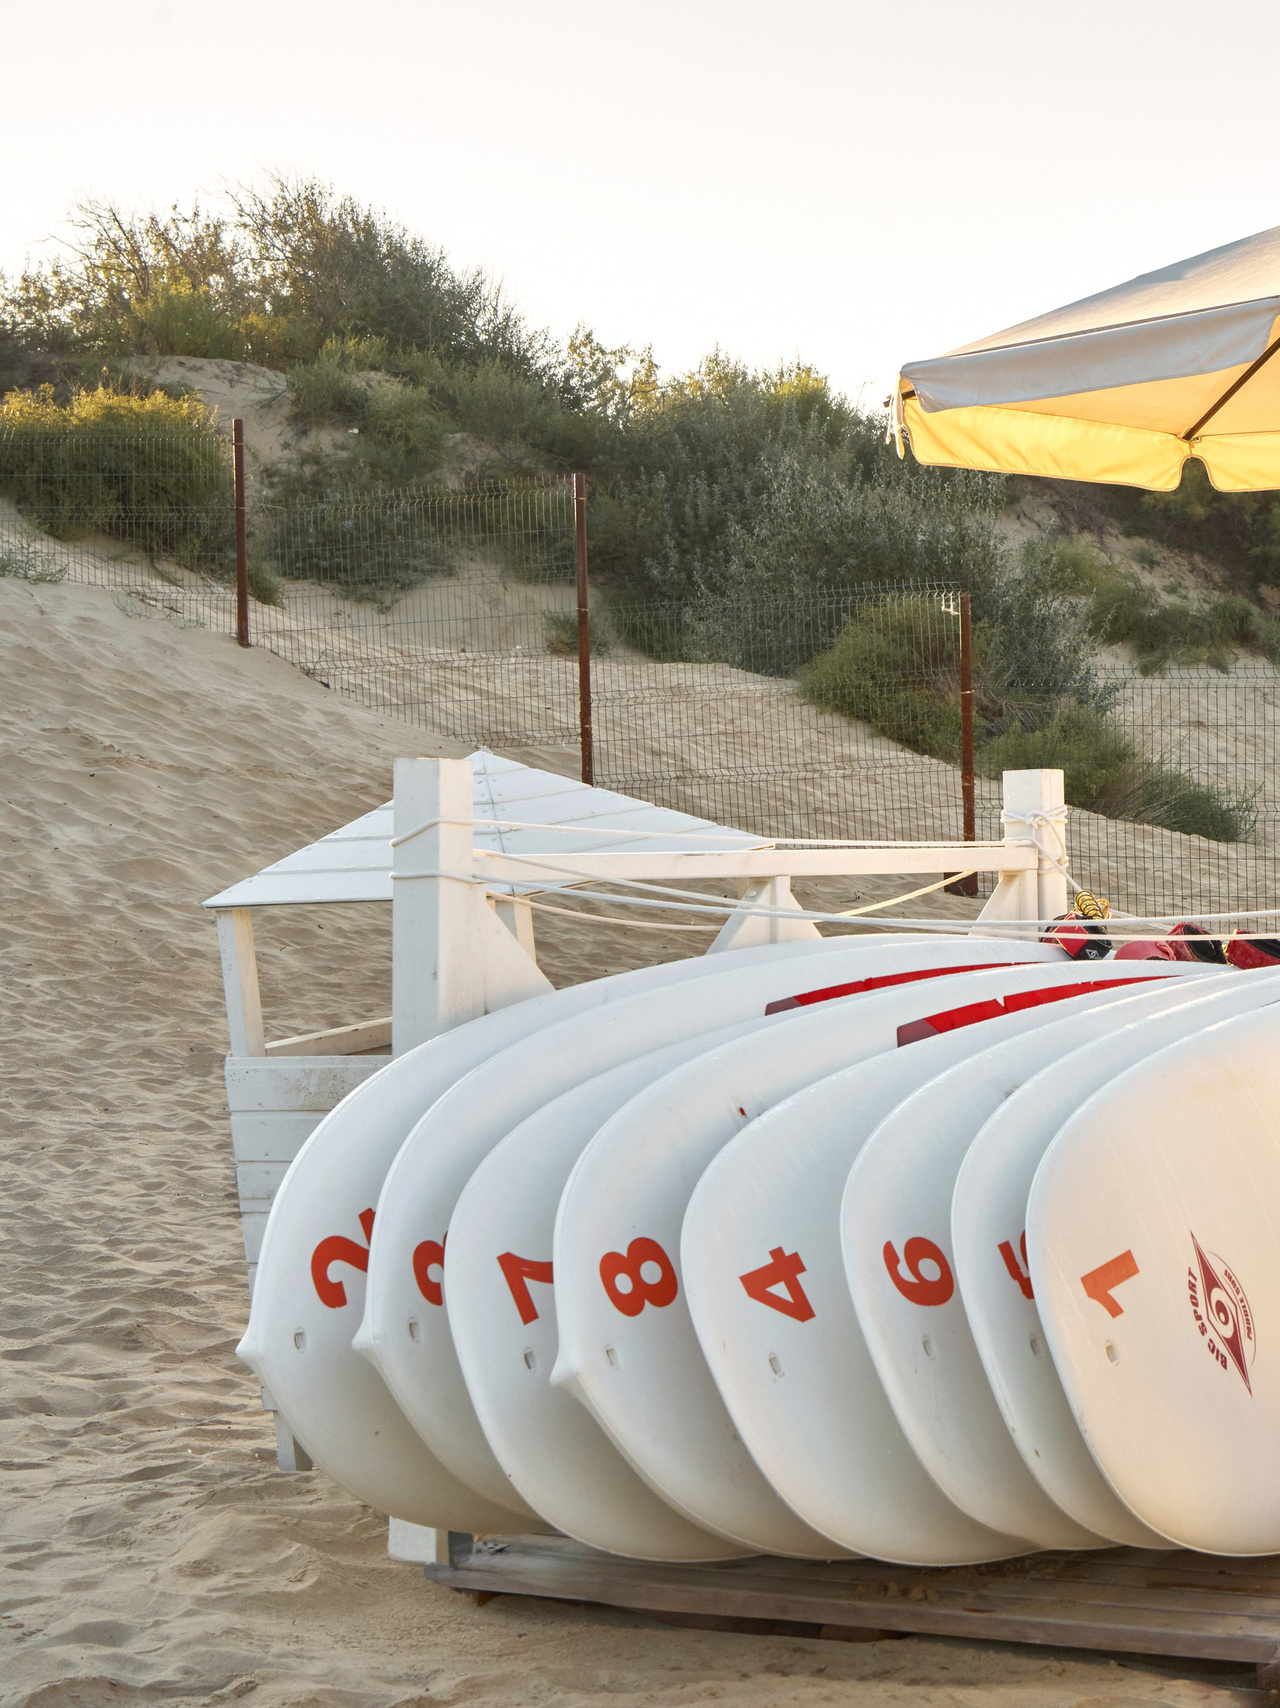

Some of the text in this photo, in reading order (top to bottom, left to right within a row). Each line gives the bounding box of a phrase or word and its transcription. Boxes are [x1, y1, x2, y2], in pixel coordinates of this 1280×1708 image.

[311, 1208, 375, 1308] 2
[497, 1252, 554, 1325] 7
[599, 1237, 678, 1317] 8
[739, 1246, 816, 1322] 4
[883, 1237, 954, 1306] 6
[1080, 1249, 1140, 1319] 1
[1188, 1267, 1228, 1371] BIC SPORT
